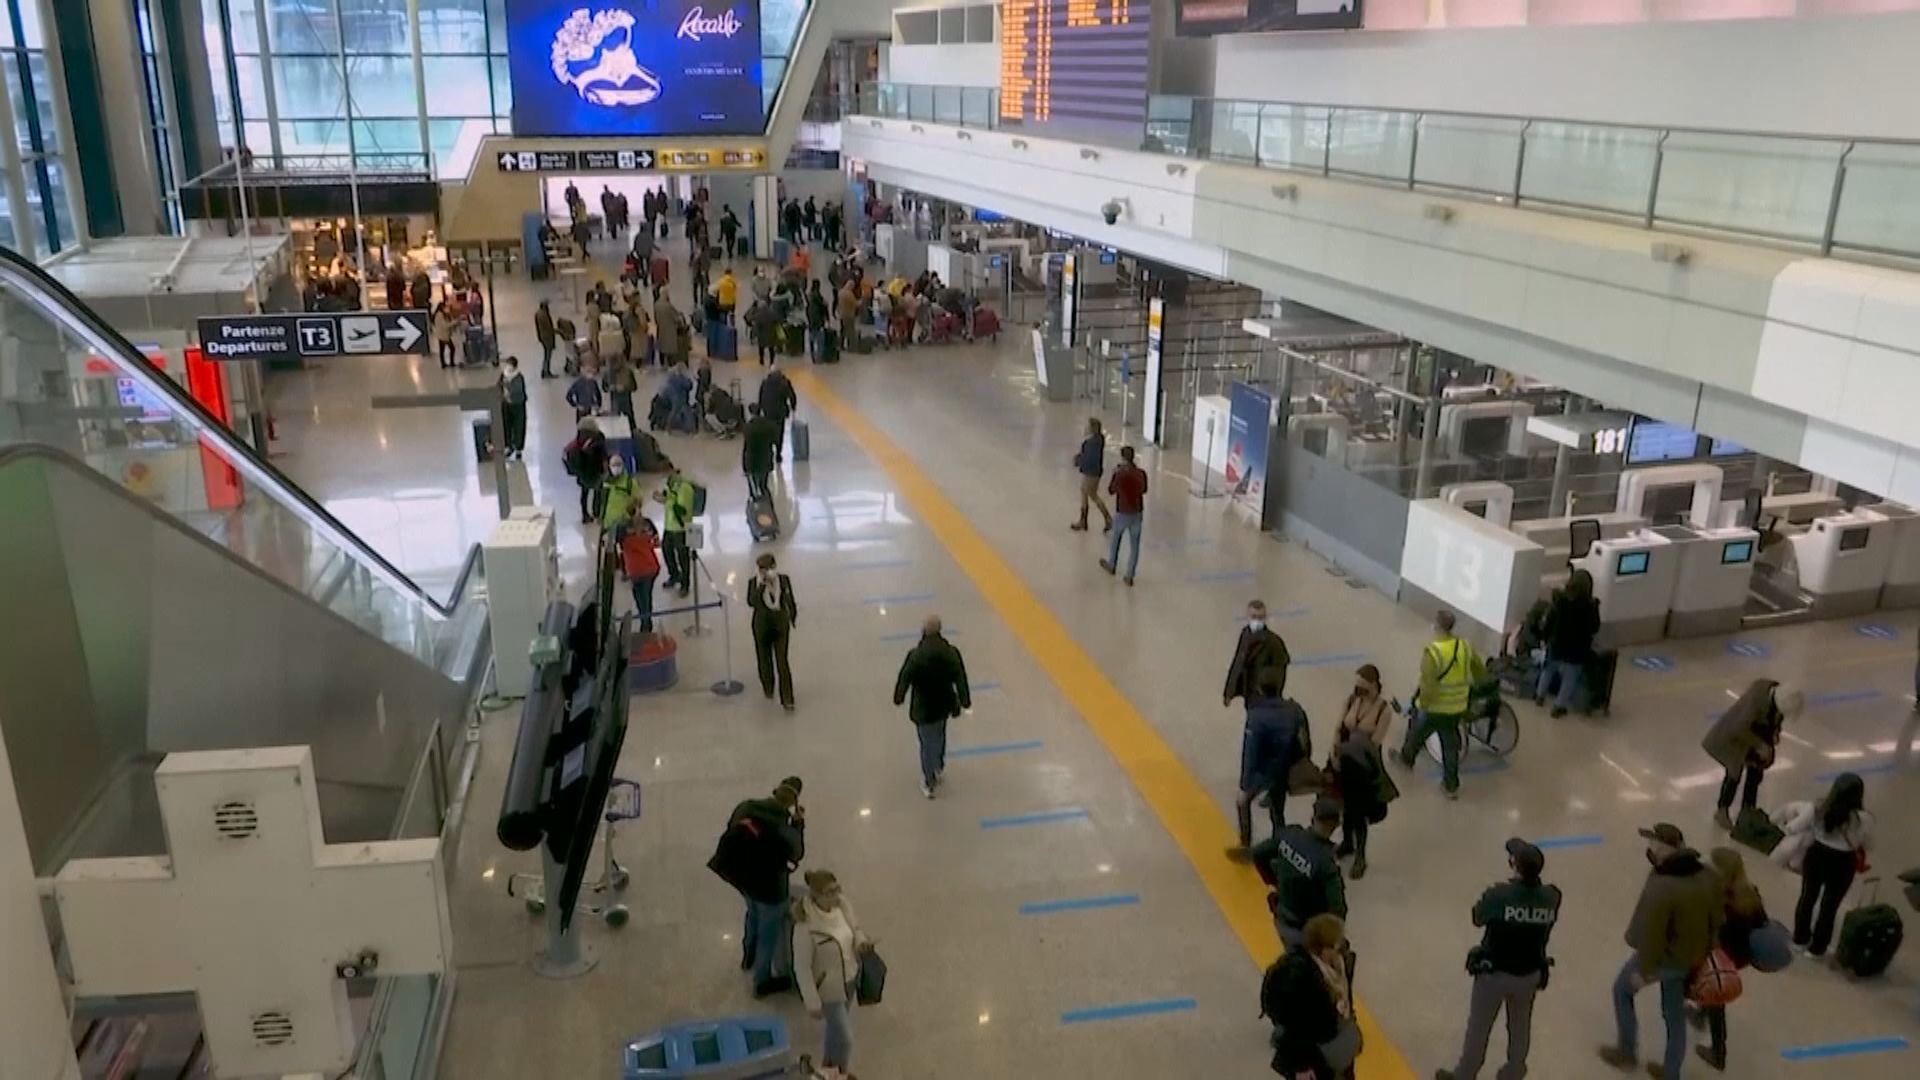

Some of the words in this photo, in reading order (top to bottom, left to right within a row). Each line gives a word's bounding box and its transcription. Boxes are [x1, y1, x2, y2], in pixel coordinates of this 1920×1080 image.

[221, 325, 286, 338] Partenze
[301, 328, 331, 346] T3
[207, 340, 288, 355] Departures
[1594, 428, 1627, 454] 181
[1279, 839, 1312, 878] POLIZIA
